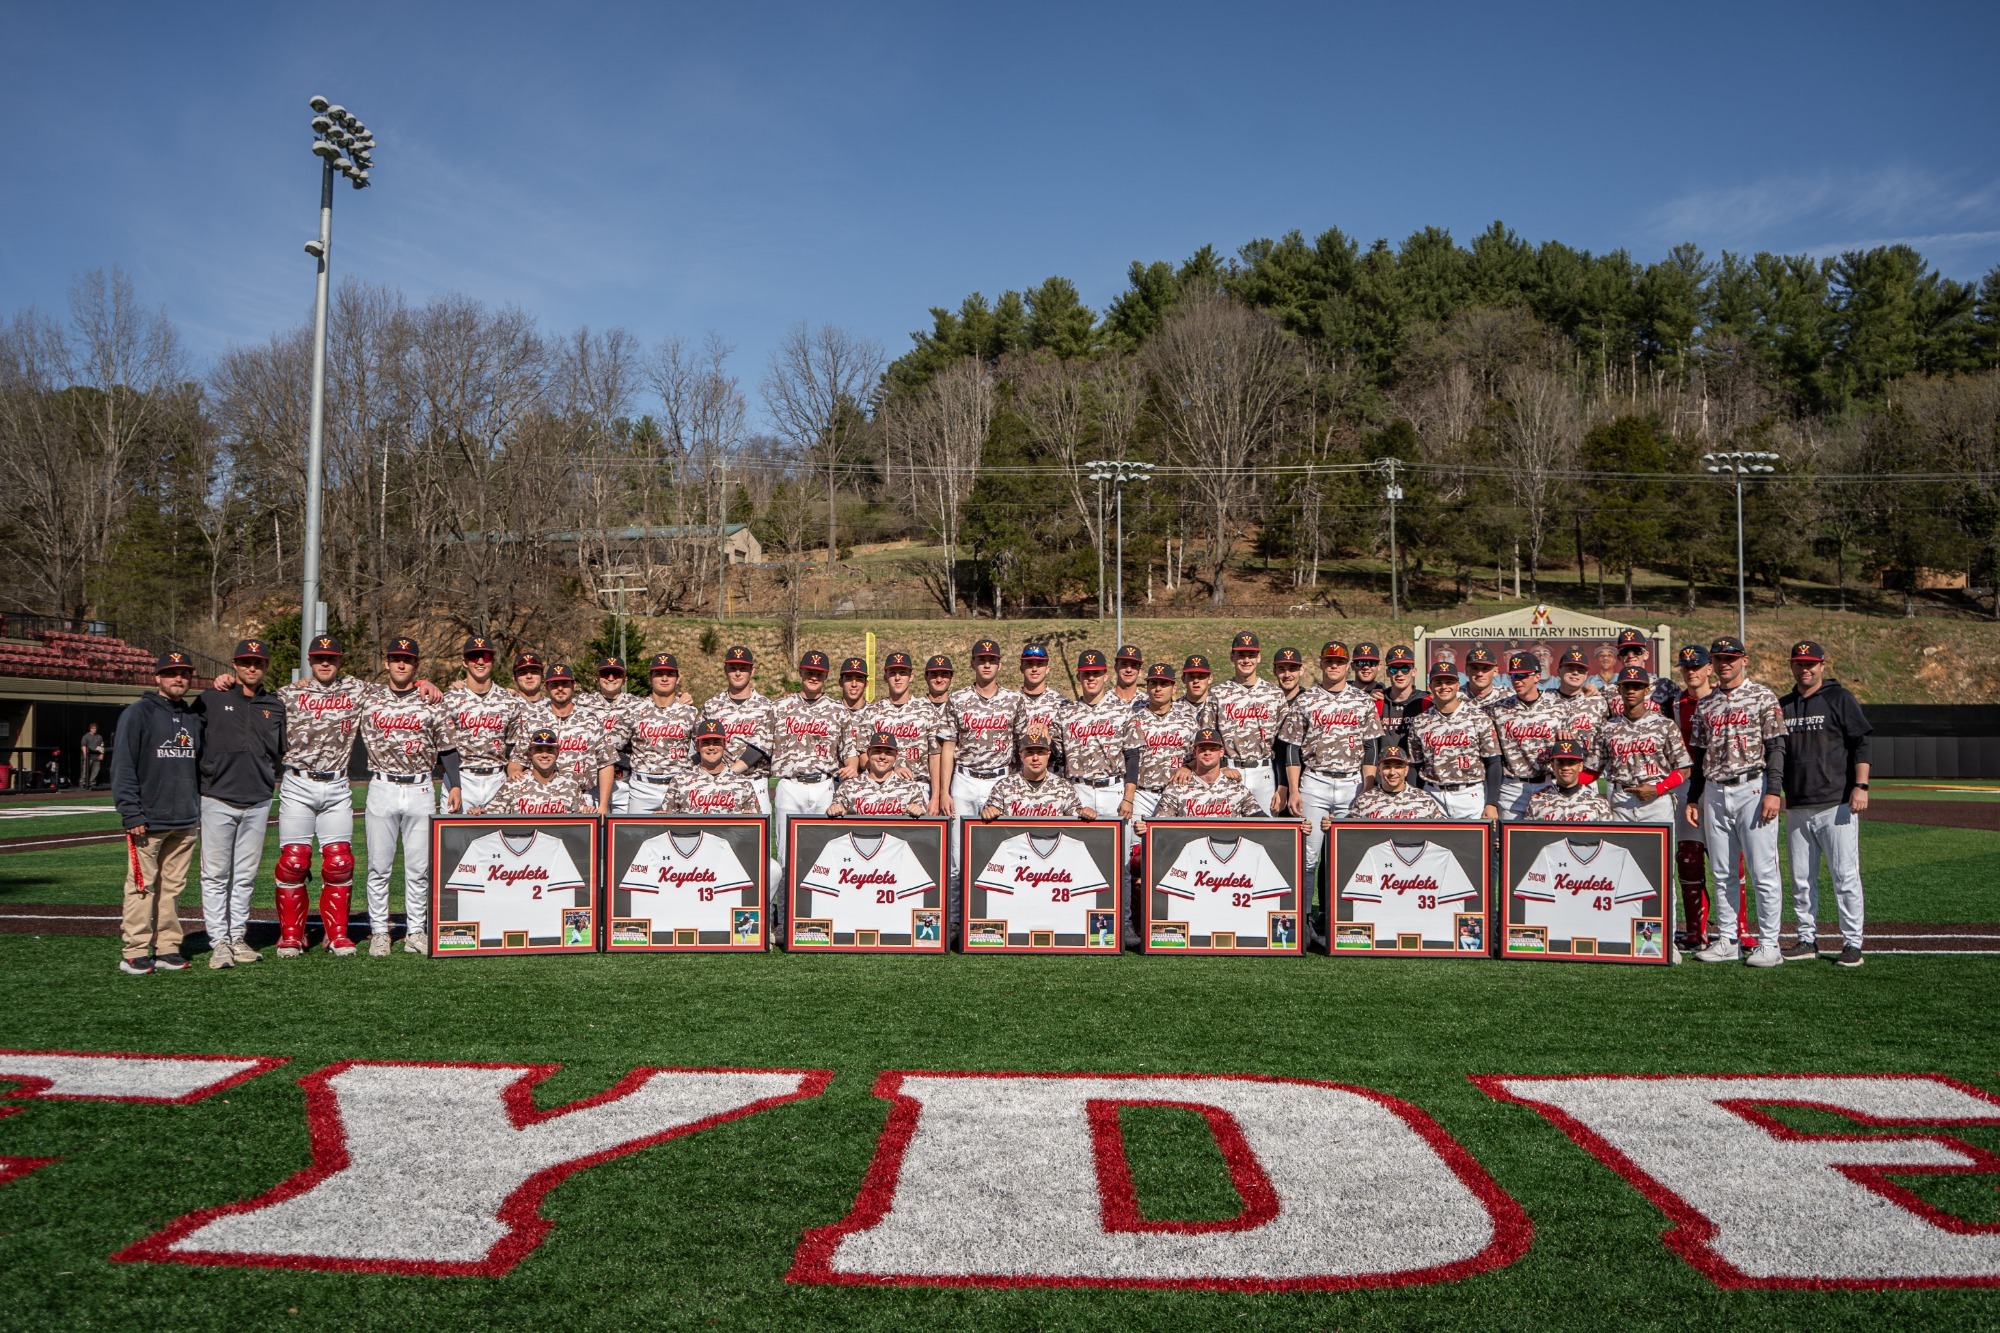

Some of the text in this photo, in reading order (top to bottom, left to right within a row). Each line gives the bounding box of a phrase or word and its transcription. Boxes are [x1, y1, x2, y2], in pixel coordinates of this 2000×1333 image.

[1450, 627, 1505, 638] VIRGINIA
[1508, 627, 1566, 638] MILITARY
[298, 692, 354, 720] Keydets
[1225, 702, 1270, 728] Keydets
[372, 711, 422, 739] Keydets
[785, 716, 828, 743] Keydets
[962, 711, 1008, 740] Keydets
[1068, 719, 1117, 747] Keydets
[1312, 708, 1359, 735] Keydets
[1504, 719, 1552, 747] Keydets
[638, 721, 685, 747] Keydets
[1347, 735, 1355, 749] 9
[1424, 728, 1471, 757] Keydets
[1733, 734, 1748, 750] 31
[405, 740, 422, 755] 27
[1609, 736, 1658, 766] Keydets
[689, 789, 736, 814] Keydets
[487, 864, 550, 887] Keydets
[658, 866, 717, 888] Keydets
[838, 868, 897, 890] Keydets
[1013, 866, 1073, 888] Keydets
[1194, 870, 1254, 893] Keydets
[1380, 873, 1439, 896] Keydets
[1554, 873, 1615, 896] Keydets
[532, 885, 542, 900] 2
[697, 887, 714, 902] 13
[876, 889, 895, 904] 20
[1051, 887, 1071, 902] 28
[1232, 892, 1251, 908] 32
[1417, 894, 1436, 910] 33
[1592, 896, 1612, 911] 43
